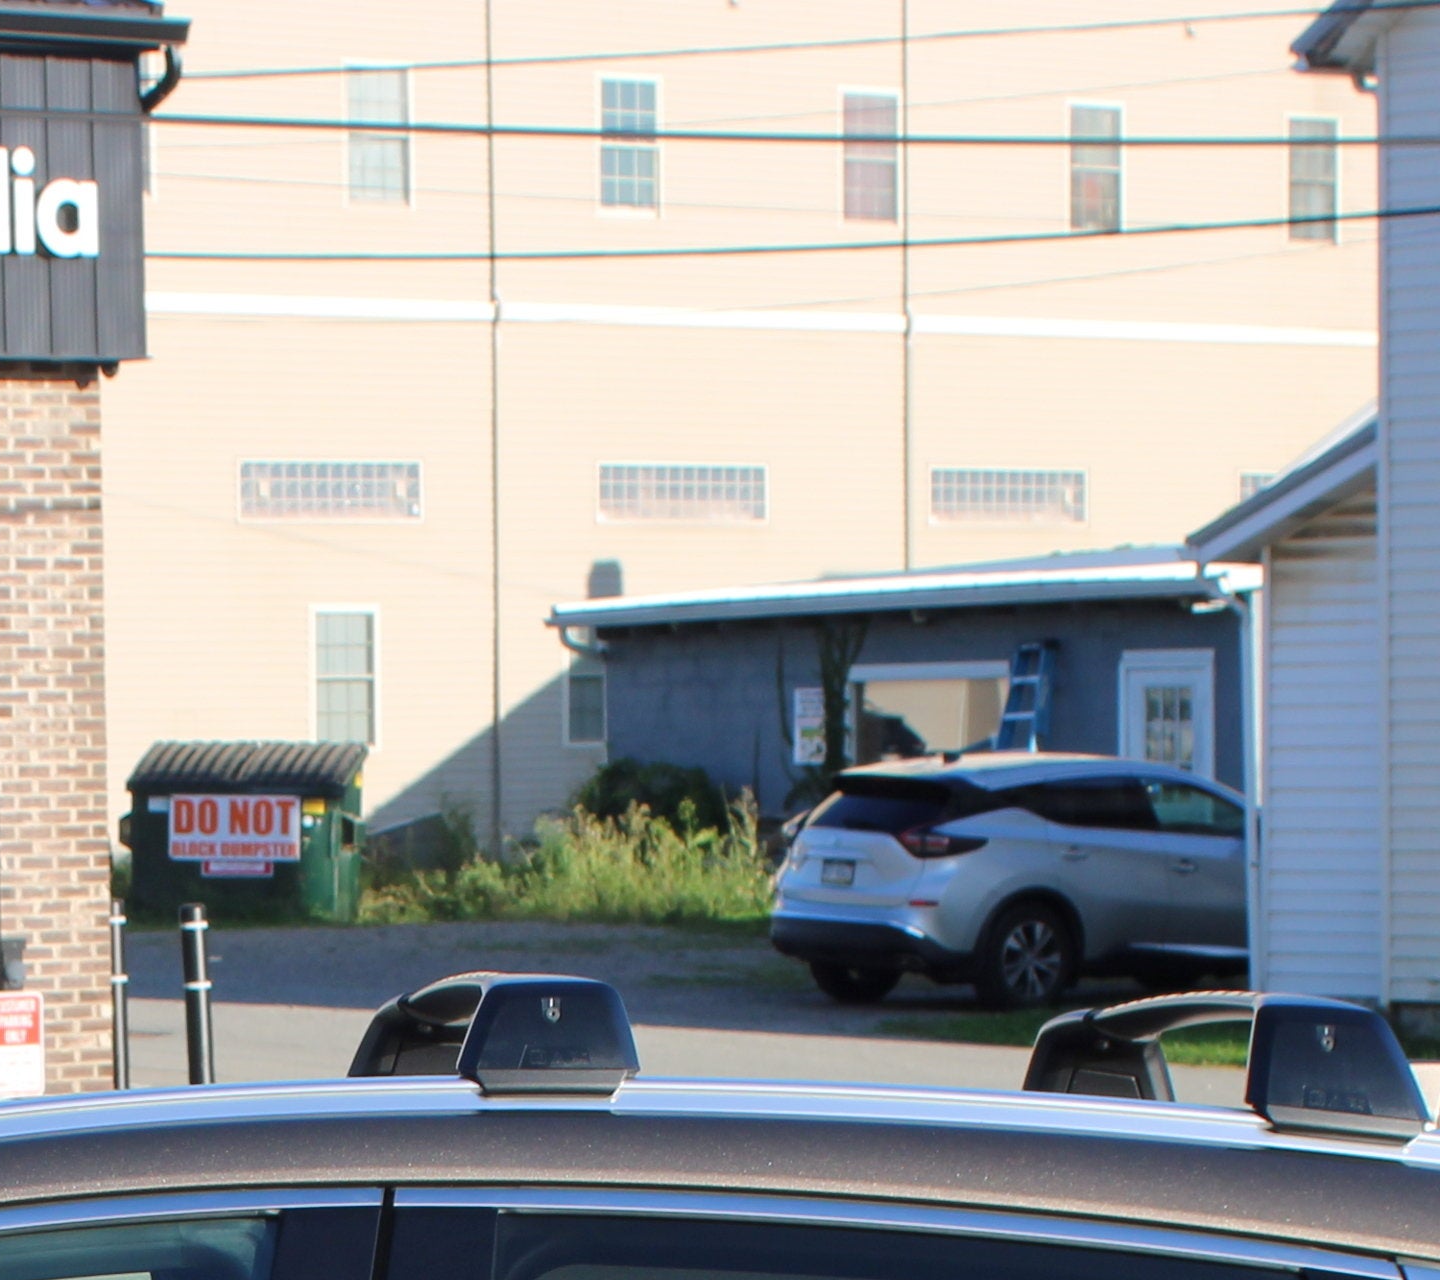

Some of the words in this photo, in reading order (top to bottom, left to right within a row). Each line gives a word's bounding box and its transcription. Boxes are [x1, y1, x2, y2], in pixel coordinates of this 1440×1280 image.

[173, 798, 219, 836] DO
[229, 798, 296, 836] NOT
[171, 841, 216, 857] BLOCK
[220, 841, 297, 858] DUMPSTER
